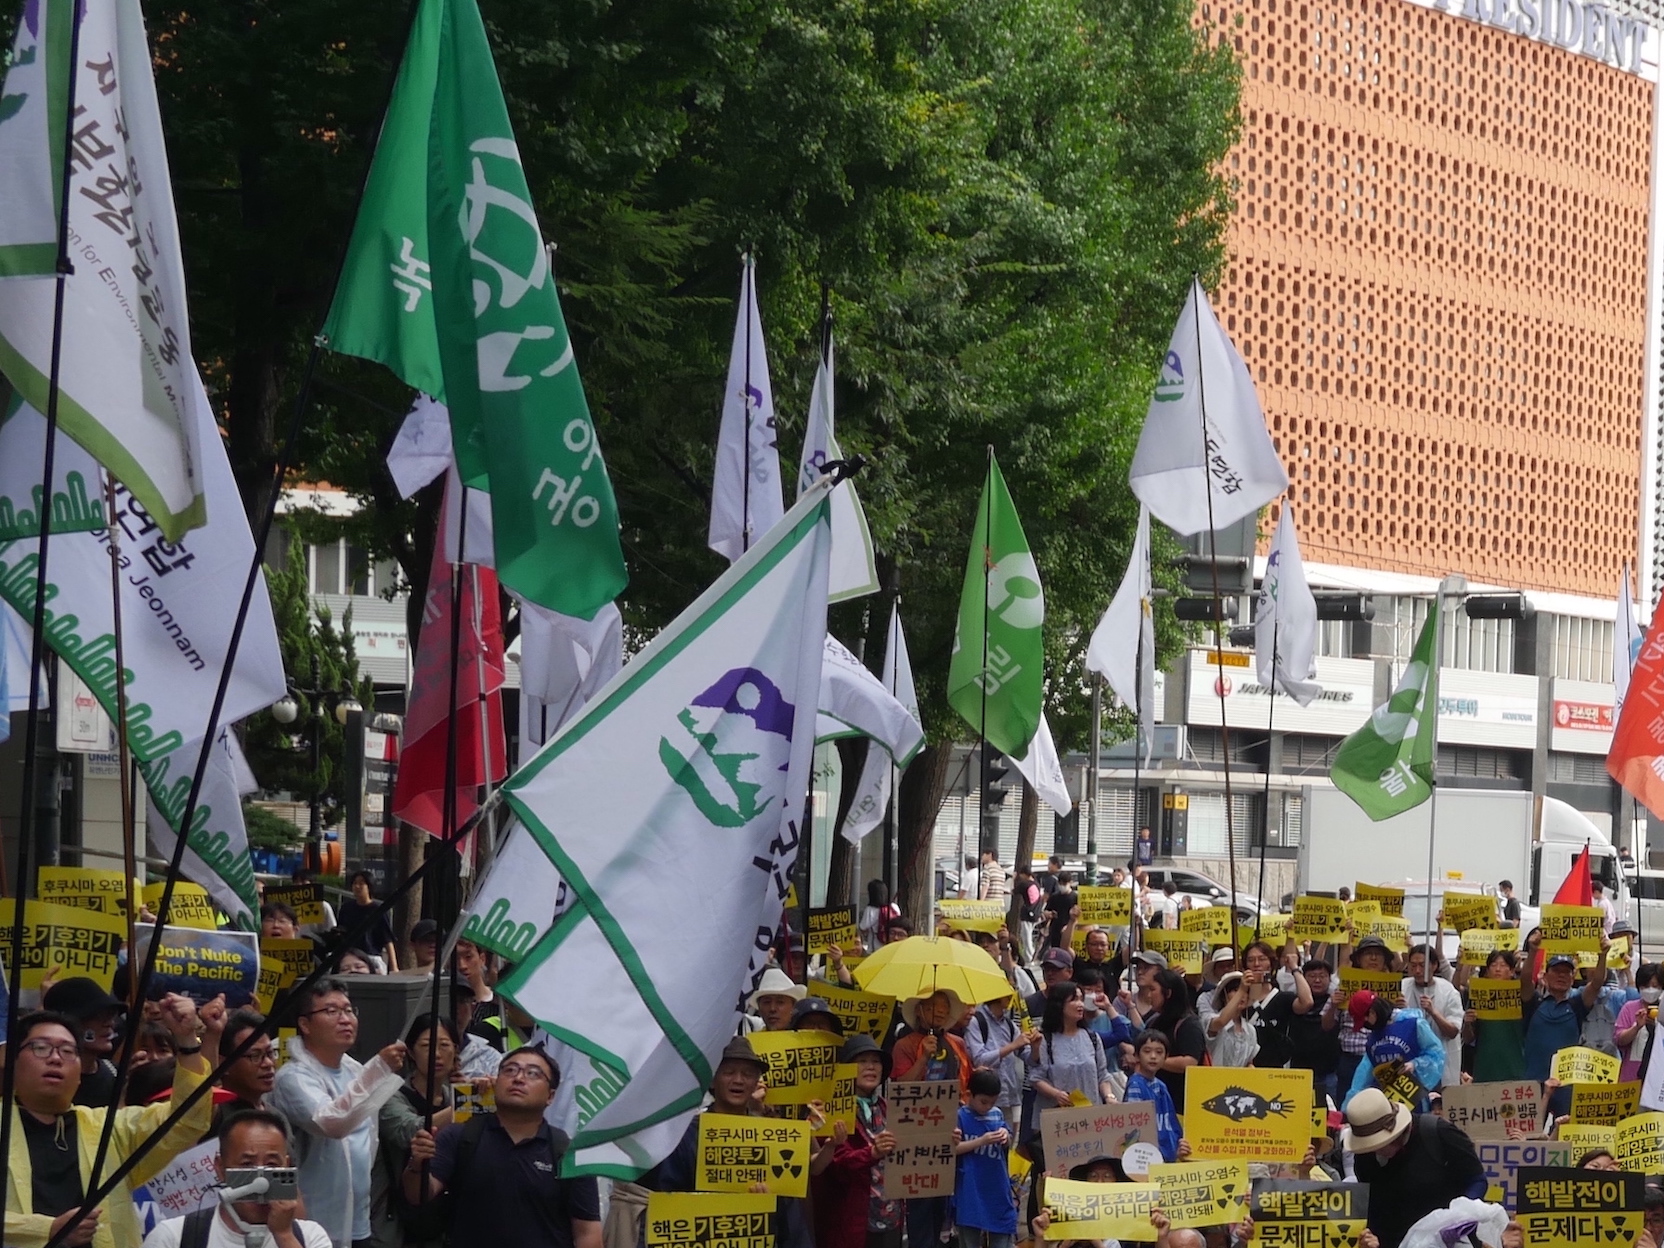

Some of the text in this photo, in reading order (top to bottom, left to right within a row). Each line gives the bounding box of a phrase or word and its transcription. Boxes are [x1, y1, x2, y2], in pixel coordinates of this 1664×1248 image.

[155, 944, 242, 964] Don't Nuke
[155, 960, 243, 982] The Pacific
[1269, 1102, 1281, 1111] NO
[1448, 1103, 1538, 1125] 후쿠시마 방류
[705, 1128, 802, 1143] 후쿠시마 오염수
[1223, 1127, 1271, 1138] 윤석열 정부는
[705, 1147, 769, 1166] 해양투기
[1055, 1139, 1104, 1157] 해양 투기
[1197, 1145, 1297, 1157] 수산물 수입 금지를 강화하라!
[705, 1167, 767, 1184] 절대 안돼!
[903, 1173, 938, 1195] 반대
[1154, 1166, 1240, 1189] 후쿠시마 오염수
[1524, 1179, 1626, 1208] 핵발전이
[653, 1213, 770, 1240] 핵은 기후위기
[1258, 1225, 1329, 1248] 문제다
[1528, 1215, 1601, 1243] 문제다
